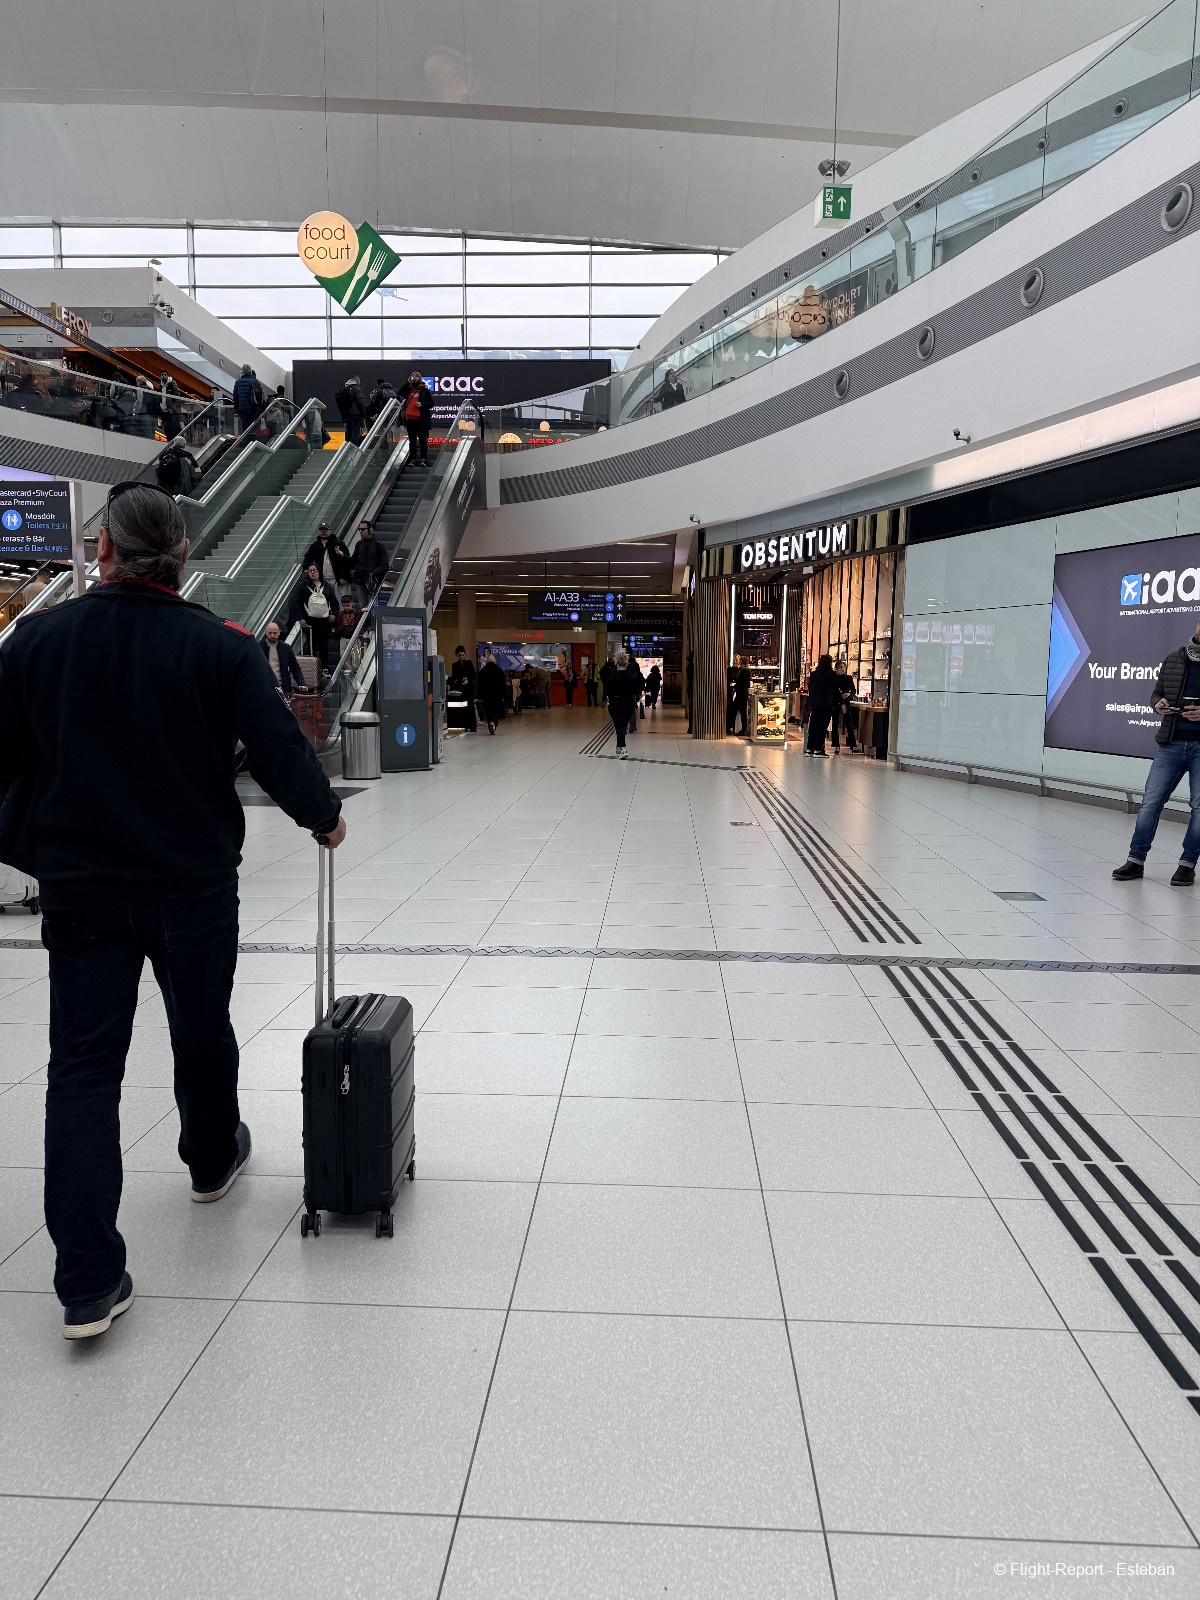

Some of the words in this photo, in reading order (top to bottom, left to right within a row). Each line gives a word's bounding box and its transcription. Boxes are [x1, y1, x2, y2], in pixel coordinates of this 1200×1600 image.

[304, 223, 346, 240] food
[304, 243, 351, 260] court
[54, 303, 92, 338] LEROY
[434, 376, 484, 392] iaac
[13, 498, 45, 506] Premium
[25, 512, 56, 520] Mosdók
[26, 521, 50, 529] Toilets
[741, 523, 848, 568] OBSENTUM
[544, 592, 580, 603] A1-A33
[1088, 662, 1118, 679] Your
